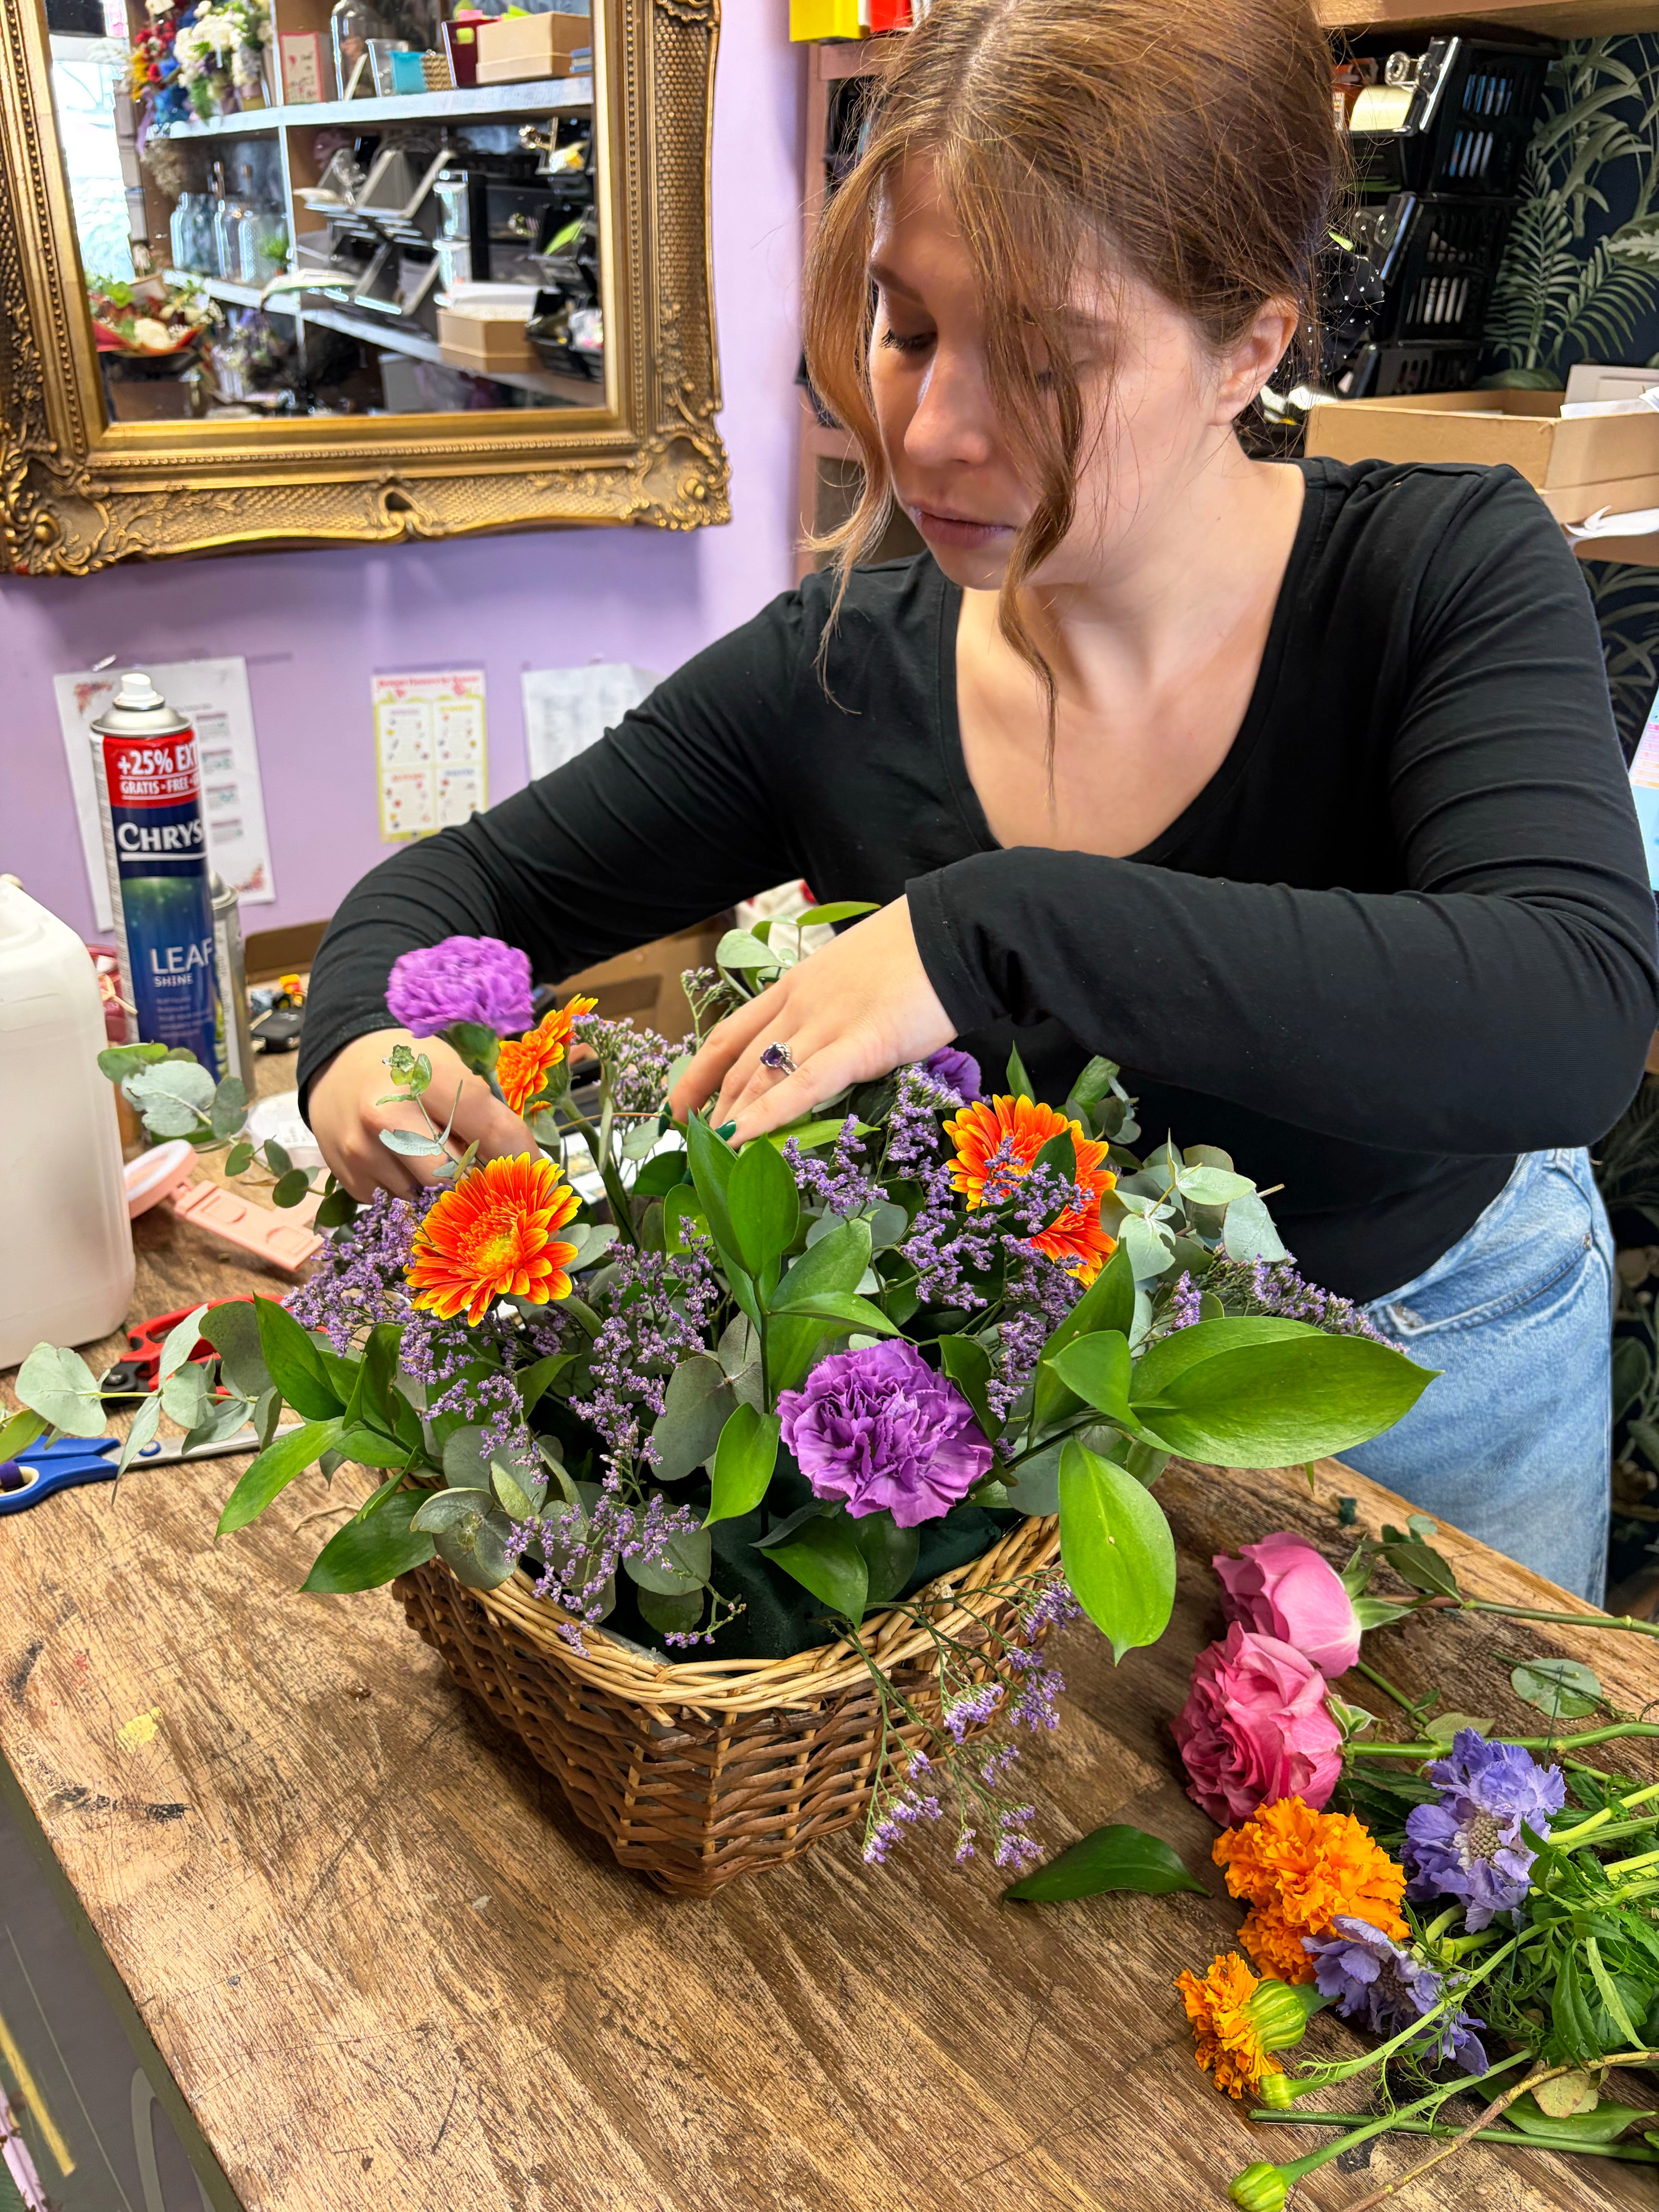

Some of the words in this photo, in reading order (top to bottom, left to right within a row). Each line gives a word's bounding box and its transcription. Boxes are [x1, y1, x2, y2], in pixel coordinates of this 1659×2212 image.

[118, 748, 174, 775] +25%
[120, 780, 160, 794] GRATIS
[167, 775, 189, 793] FREE
[151, 938, 212, 974] LEAF
[155, 972, 194, 988] SHINE
